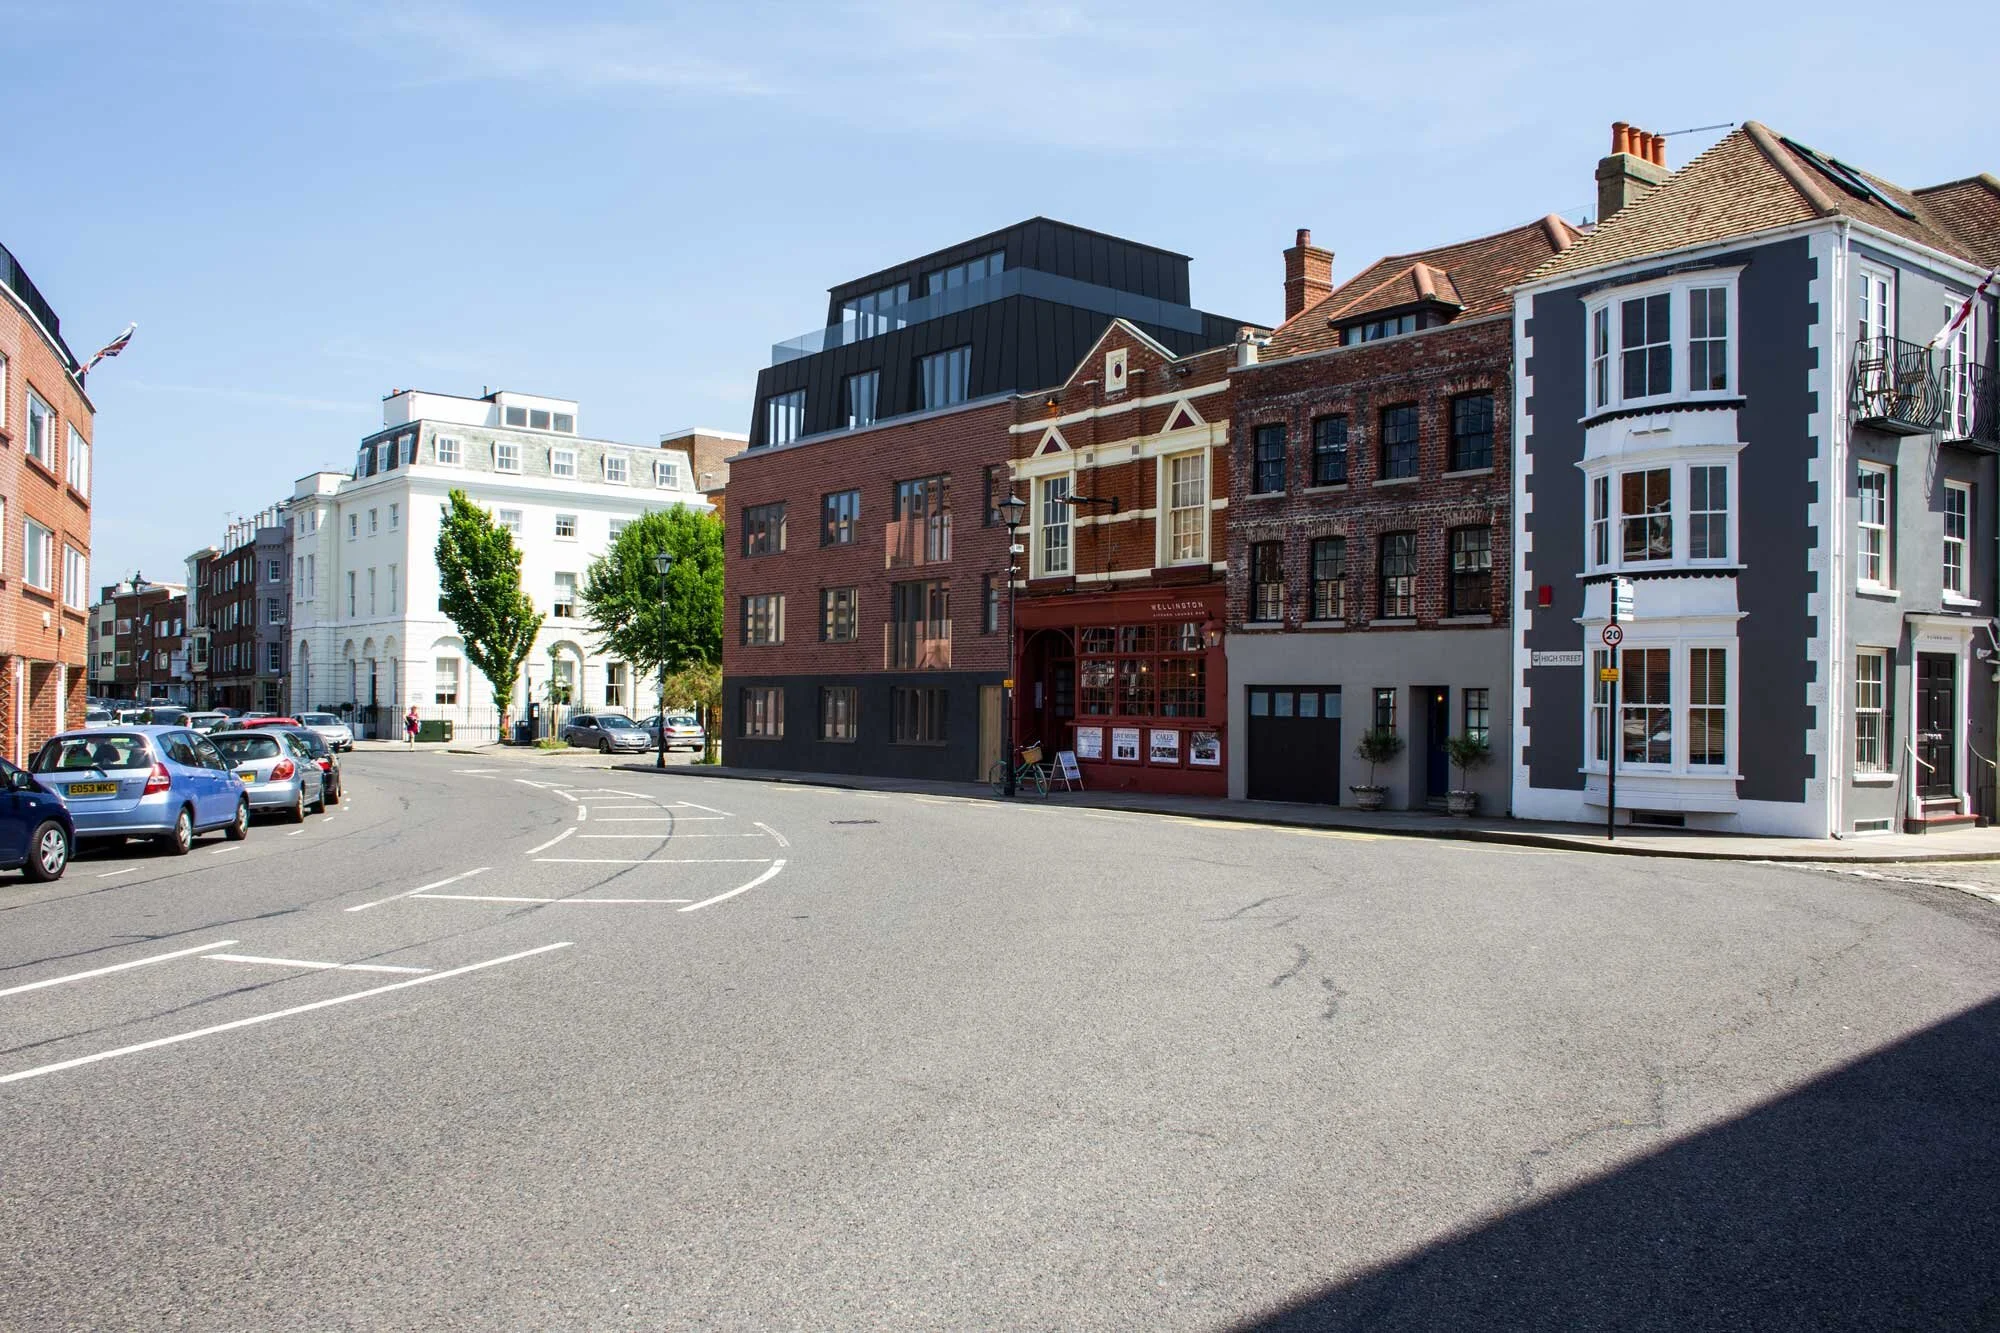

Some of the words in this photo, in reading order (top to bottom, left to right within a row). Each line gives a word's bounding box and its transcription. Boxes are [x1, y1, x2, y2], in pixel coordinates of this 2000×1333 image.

[1151, 601, 1203, 610] WELLINGTON
[1606, 630, 1620, 639] 20
[1541, 655, 1557, 663] HIGH
[1559, 654, 1581, 663] STREET
[96, 783, 115, 792] WKC
